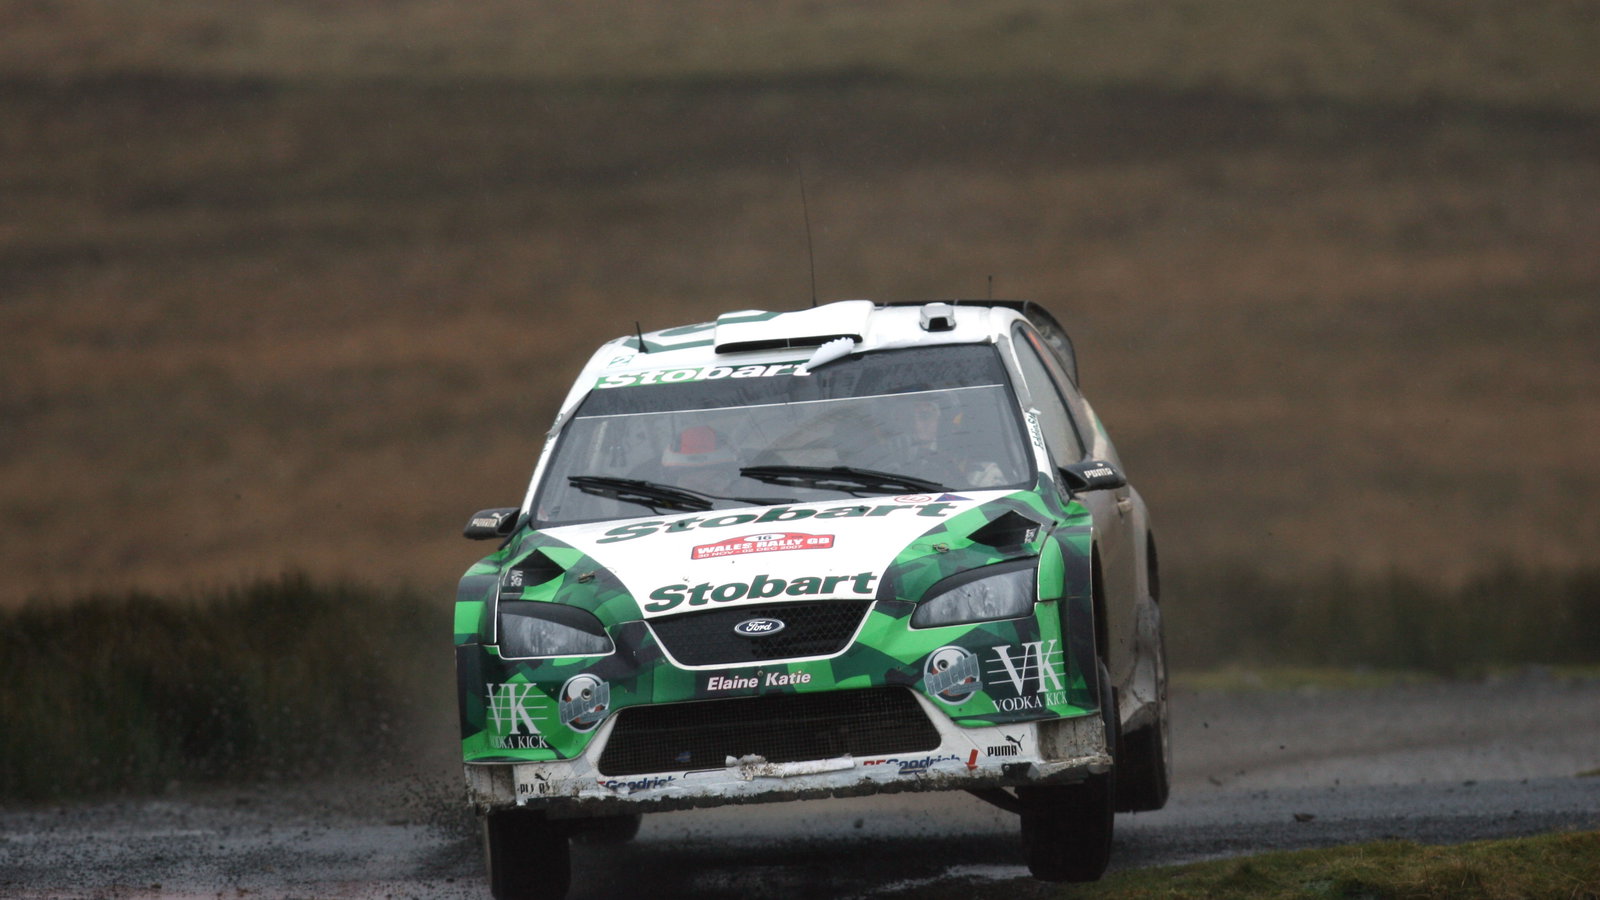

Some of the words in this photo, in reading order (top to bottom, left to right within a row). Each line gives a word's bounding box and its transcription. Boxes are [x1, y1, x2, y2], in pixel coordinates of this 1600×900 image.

[598, 362, 811, 389] Stobart
[1084, 468, 1114, 479] PUMA
[596, 502, 957, 544] Stobart
[697, 542, 753, 554] WALES
[757, 538, 804, 548] RALLY
[807, 537, 831, 545] GB
[644, 572, 878, 613] Stobart
[745, 621, 773, 632] Ford
[992, 638, 1064, 696] VK
[707, 675, 759, 691] Elaine
[765, 670, 811, 687] Katie
[486, 683, 542, 735] VK
[992, 696, 1043, 712] VODKA
[1046, 690, 1068, 707] KICK
[490, 735, 514, 749] ODKA
[518, 735, 549, 749] KICK
[987, 745, 1018, 757] PUMA
